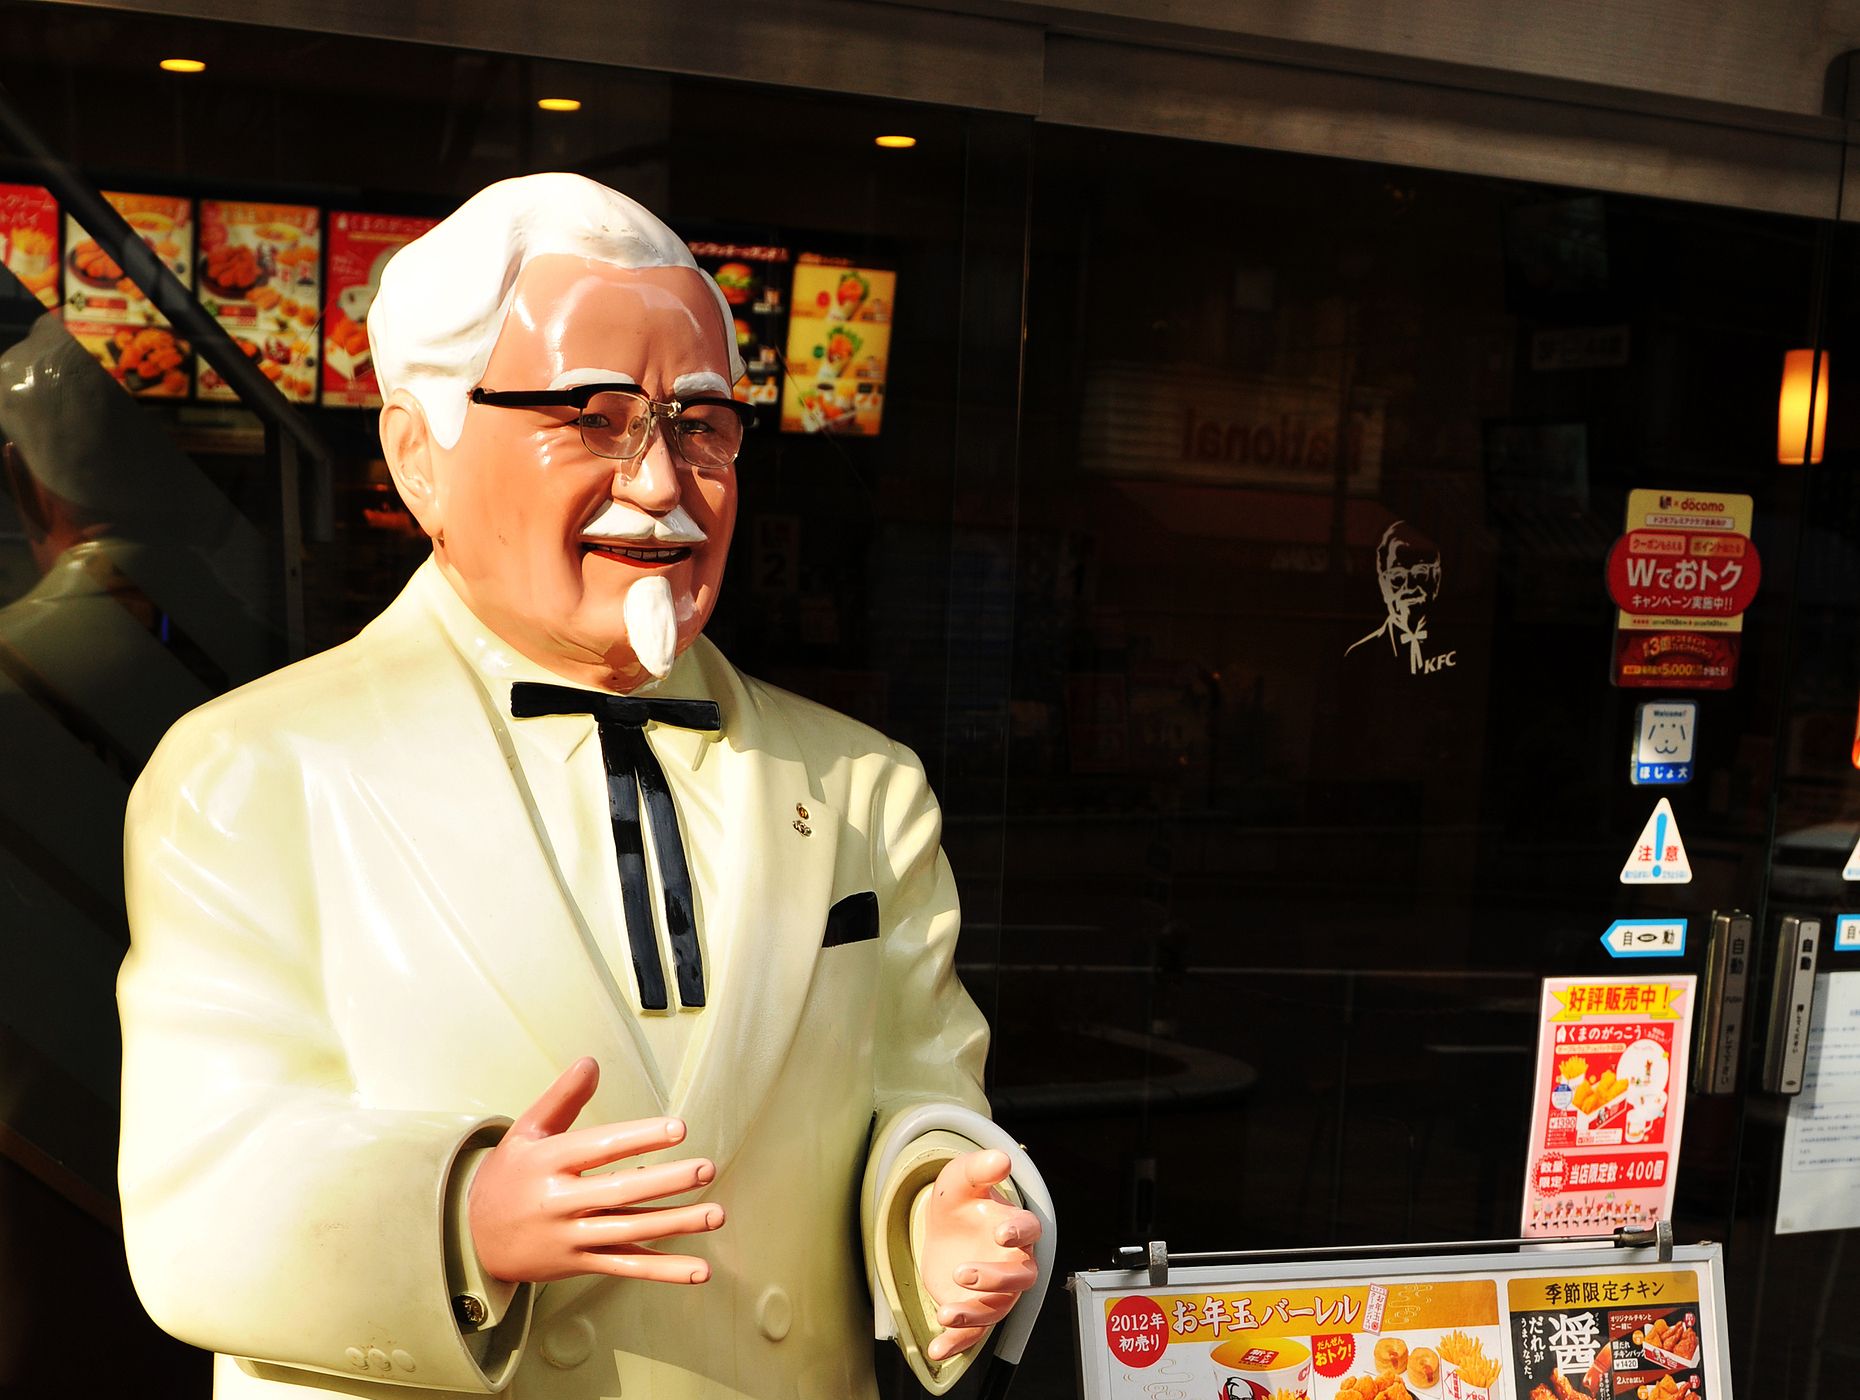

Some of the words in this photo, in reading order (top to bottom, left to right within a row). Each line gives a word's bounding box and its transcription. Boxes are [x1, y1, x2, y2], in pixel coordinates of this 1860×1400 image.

[1681, 498, 1725, 513] docomo
[1627, 558, 1743, 592] Wでおトク
[1632, 595, 1733, 611] キャンペーン実施中!!
[1424, 651, 1457, 674] KFC
[1639, 766, 1688, 779] ほじょ犬
[1569, 985, 1670, 1013] 好評販売中!
[1569, 1025, 1641, 1041] くまのがっこう
[1551, 1118, 1576, 1127] ¥1390
[1545, 1280, 1665, 1305] 季節限定チキン
[1111, 1311, 1166, 1333] 2012年
[1172, 1294, 1361, 1337] お年玉バーレル
[1119, 1334, 1159, 1354] 初売り
[1317, 1338, 1344, 1349] だんぜん
[1315, 1344, 1352, 1366] おトク!
